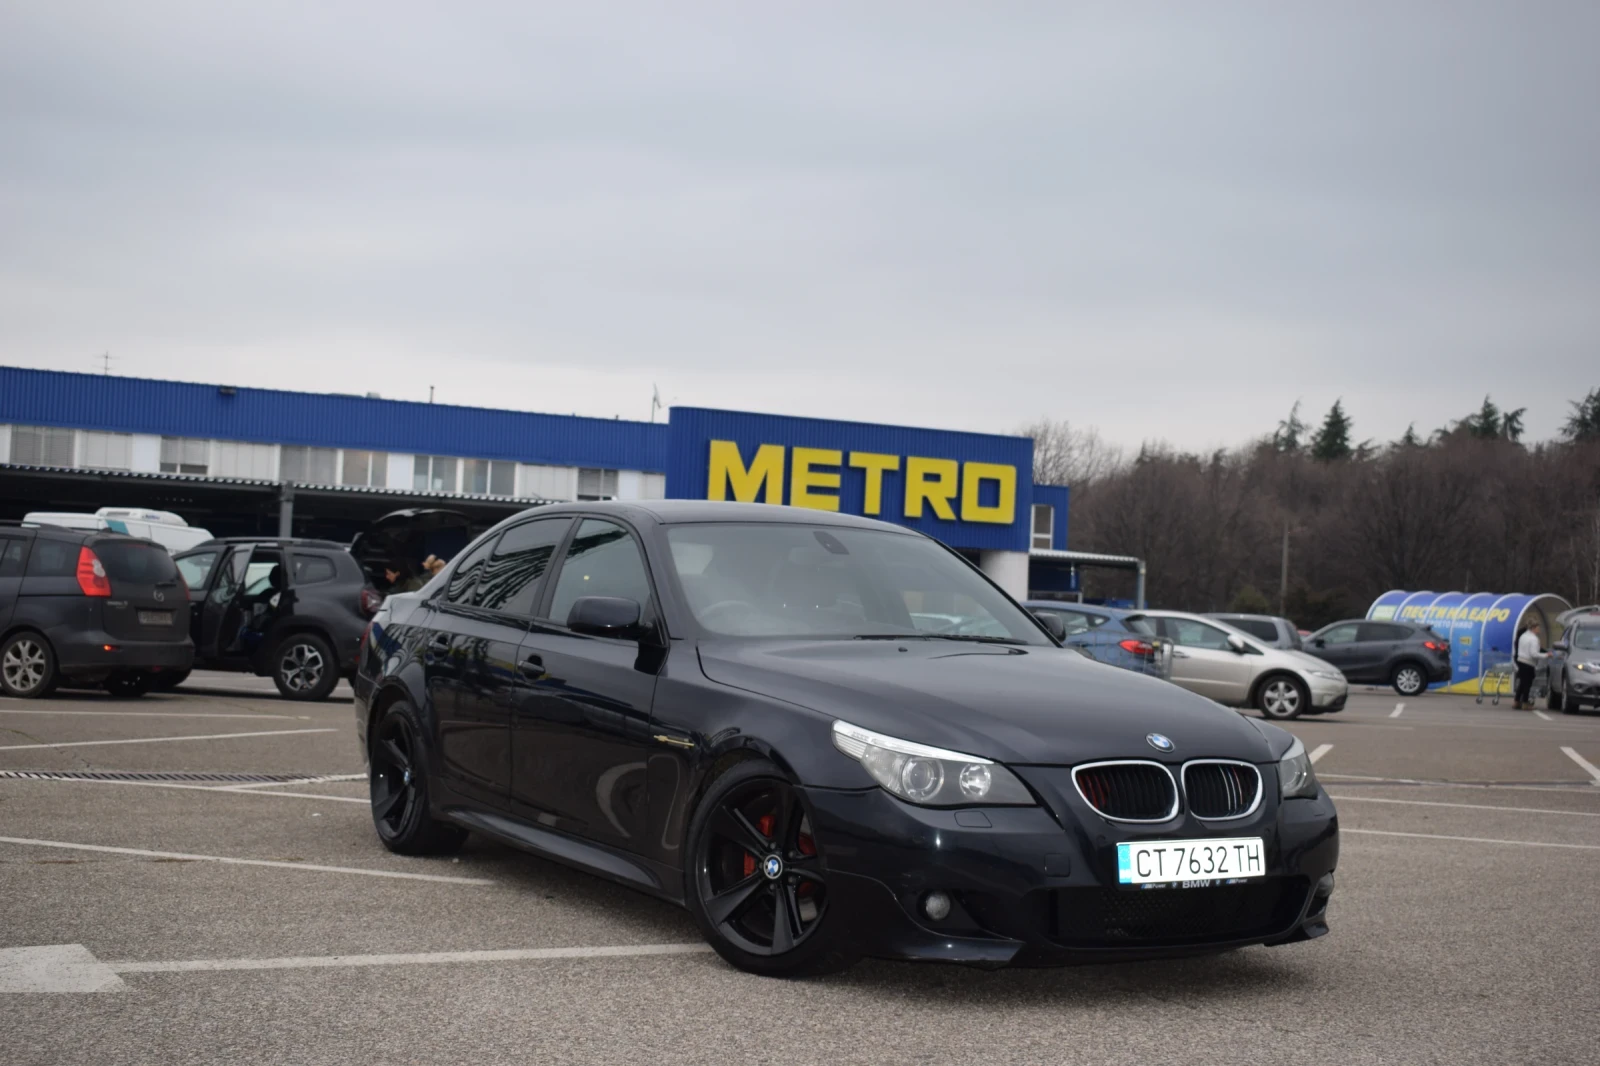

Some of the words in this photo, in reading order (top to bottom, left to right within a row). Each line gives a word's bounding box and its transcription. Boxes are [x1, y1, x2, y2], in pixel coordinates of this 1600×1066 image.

[707, 439, 1016, 525] METRO
[1173, 845, 1229, 876] 7632
[1182, 879, 1211, 889] BMW
